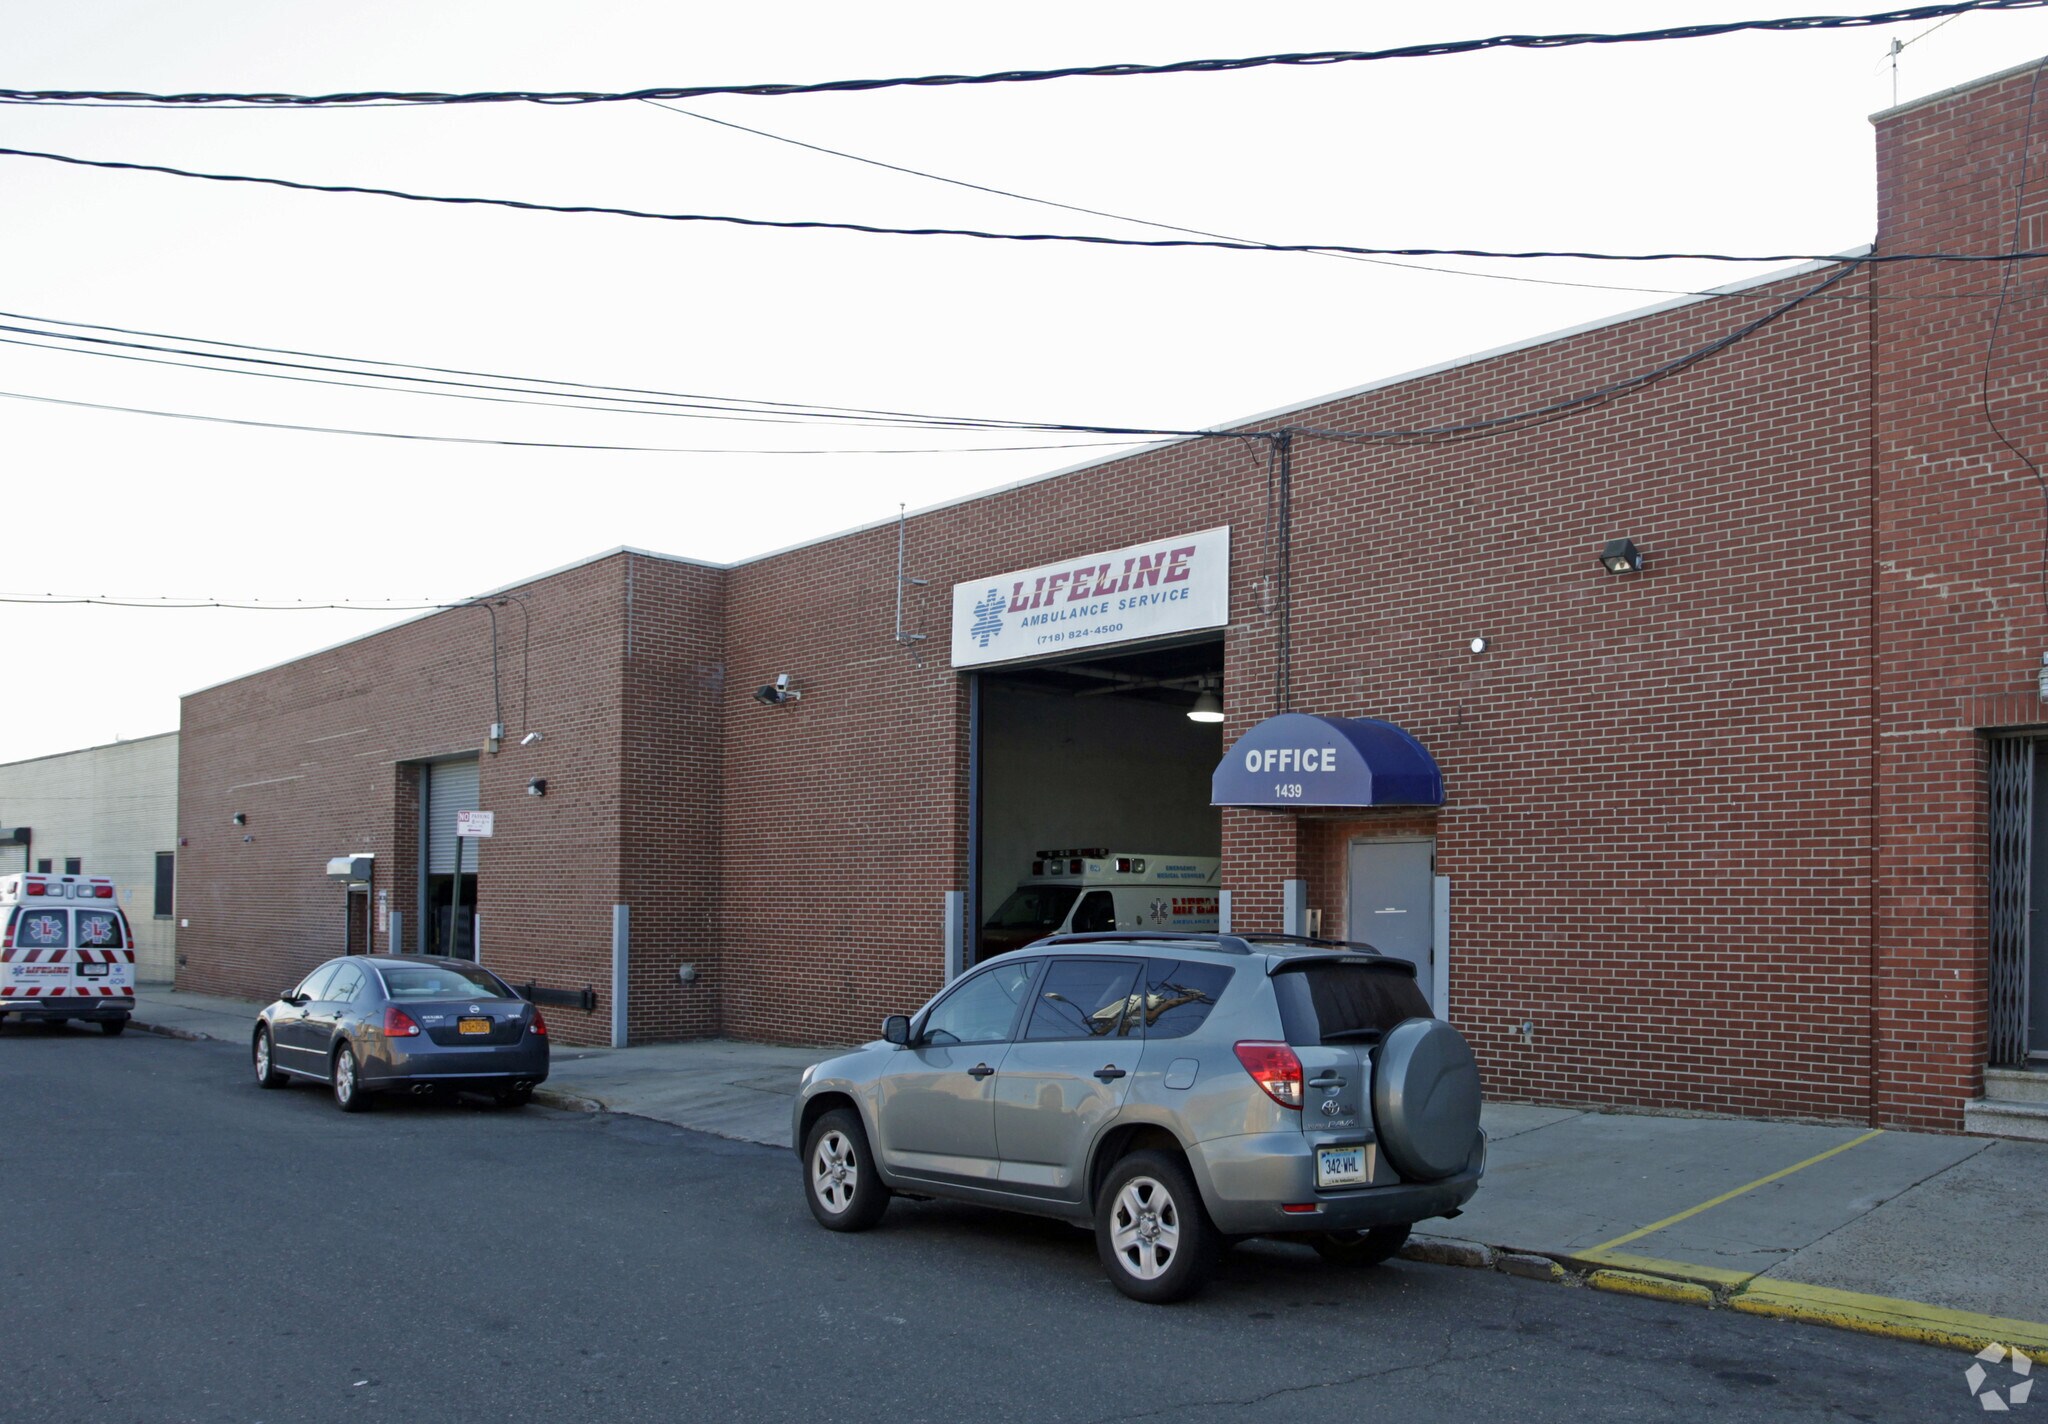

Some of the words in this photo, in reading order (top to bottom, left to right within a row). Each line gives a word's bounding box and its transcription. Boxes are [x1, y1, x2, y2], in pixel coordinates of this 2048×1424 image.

[1007, 545, 1196, 613] LIFELINE
[1021, 602, 1109, 628] AMBULANCE
[1118, 587, 1190, 611] SERVICE
[1037, 631, 1065, 645] (718)
[1068, 623, 1123, 640] 824-4500
[1245, 748, 1336, 773] OFFICE
[1274, 784, 1302, 798] 1439
[459, 812, 470, 822] NO
